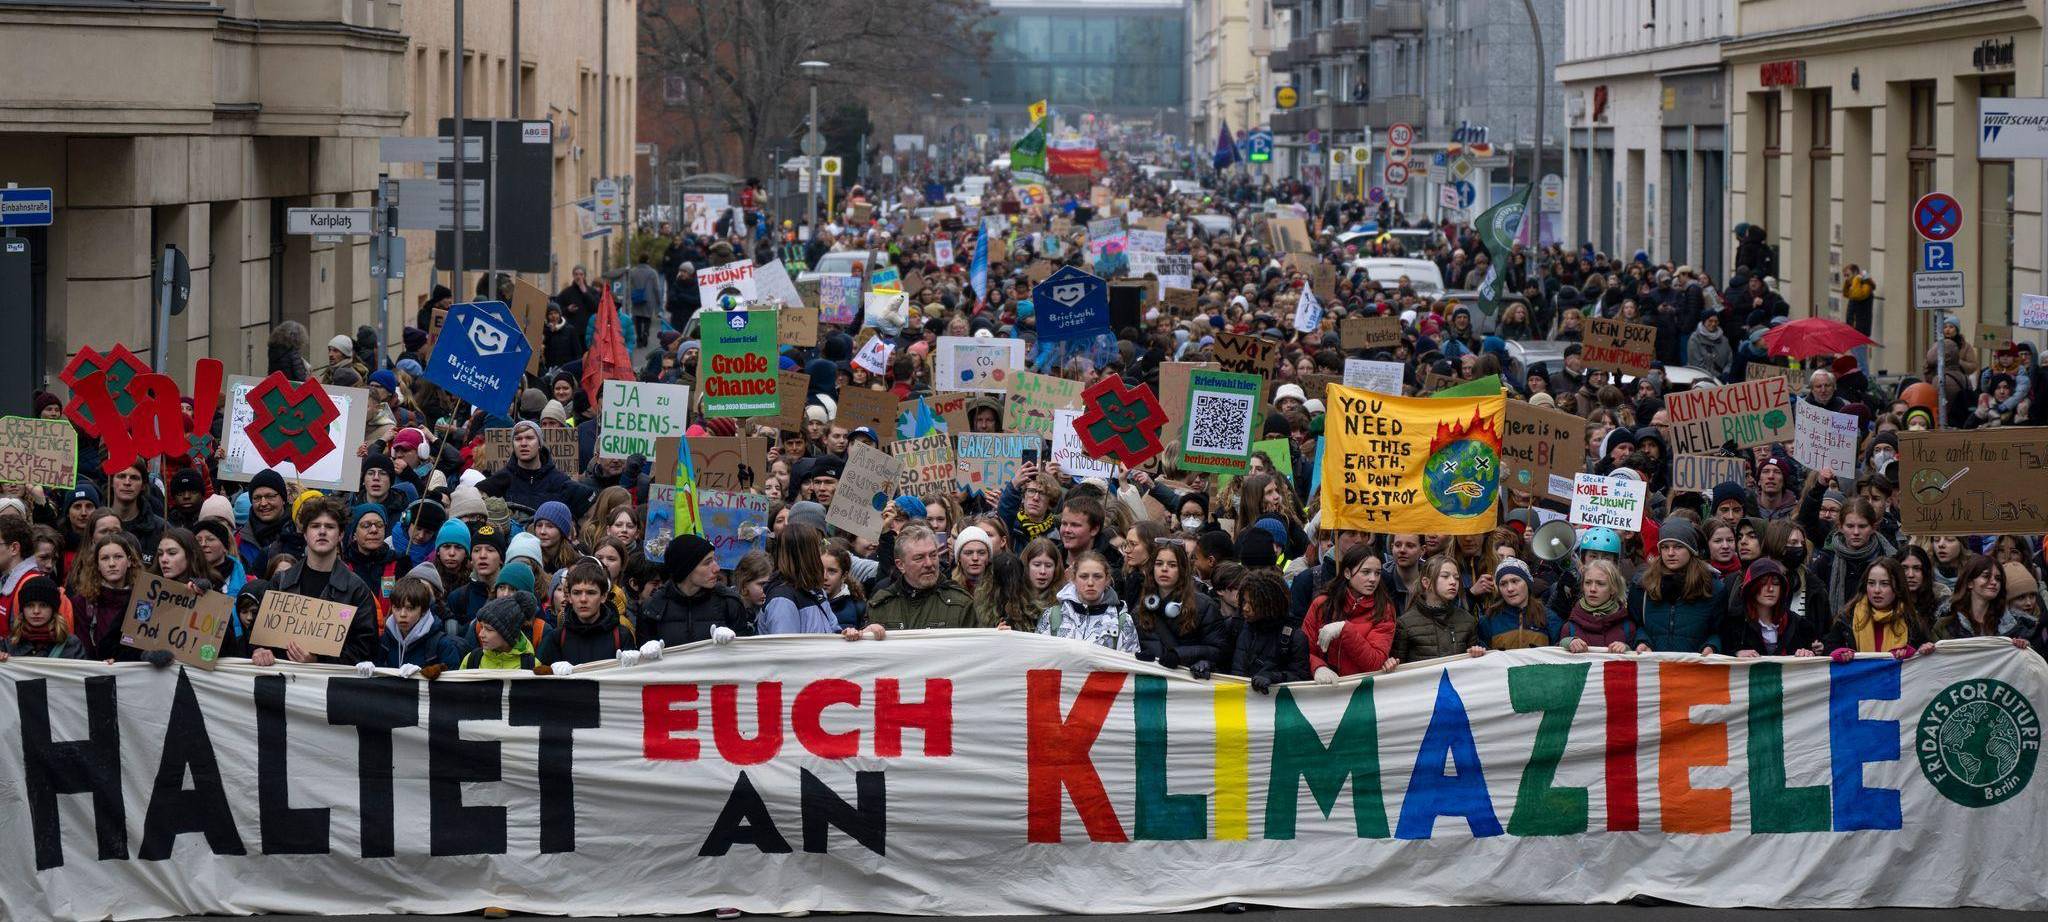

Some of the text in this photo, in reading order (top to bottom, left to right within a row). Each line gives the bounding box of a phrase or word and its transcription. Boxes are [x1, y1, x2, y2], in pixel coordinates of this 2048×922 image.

[1394, 130, 1408, 141] 30
[1453, 121, 1488, 143] dm
[1407, 158, 1425, 169] dm
[2, 202, 48, 212] Einbahnstraße
[310, 214, 352, 229] Karlplatz
[1928, 246, 1944, 267] P
[698, 265, 753, 286] ZUKUNFT
[613, 281, 621, 293] P
[1049, 308, 1096, 321] Briefwahl
[1611, 339, 1627, 348] AUF
[1624, 325, 1652, 343] BOCK
[447, 353, 500, 390] Briefwahl
[711, 352, 768, 375] Große
[705, 376, 776, 397] Chance
[1194, 375, 1257, 390] Briefwahl hier:
[613, 384, 640, 407] JA
[1339, 396, 1383, 413] YOU
[1668, 378, 1789, 423] KLIMASCHUTZ
[6, 418, 68, 438] RESPECT
[603, 411, 680, 435] LEBENS-
[1345, 415, 1403, 436] NEED
[1504, 419, 1569, 440] here is no
[1674, 412, 1764, 454] WEIL BAUM
[894, 434, 947, 455] IT'S OUR
[957, 435, 993, 458] GANZ
[1369, 439, 1411, 456] THIS
[1900, 437, 1936, 463] The
[1999, 448, 2009, 461] a
[4, 451, 57, 472] EXPECT
[1054, 449, 1071, 462] NO
[1184, 453, 1246, 470] berlin2030.org
[1344, 453, 1405, 471] EARTH,
[845, 470, 881, 492] eure
[901, 463, 953, 484] SO STOP
[983, 460, 1015, 486] EIS
[1344, 472, 1403, 487] SO DON'T
[1674, 454, 1746, 489] GO VEGAN
[947, 479, 957, 491] IT
[1577, 484, 1608, 496] KOHLE
[1614, 488, 1621, 497] in
[698, 490, 747, 510] LASTIK
[1344, 488, 1418, 505] DESTROY
[1590, 496, 1638, 512] ZUKUNFT
[1366, 509, 1391, 522] IT
[1580, 504, 1598, 512] nicht
[1951, 499, 1974, 522] the
[1581, 512, 1632, 528] KRAFTWERK
[146, 580, 199, 610] Spread
[267, 591, 334, 620] THERE IS
[138, 624, 160, 638] not
[189, 612, 227, 638] LOVE
[264, 615, 346, 642] NO PLANET B
[641, 678, 953, 765] EUCH
[1922, 683, 2039, 783] FRIDAYS FOR FUTURE
[1026, 658, 1903, 844] KLIMAZIELE
[16, 666, 600, 871] HALTET
[1984, 775, 2020, 800] Berlin
[698, 766, 886, 856] AN
